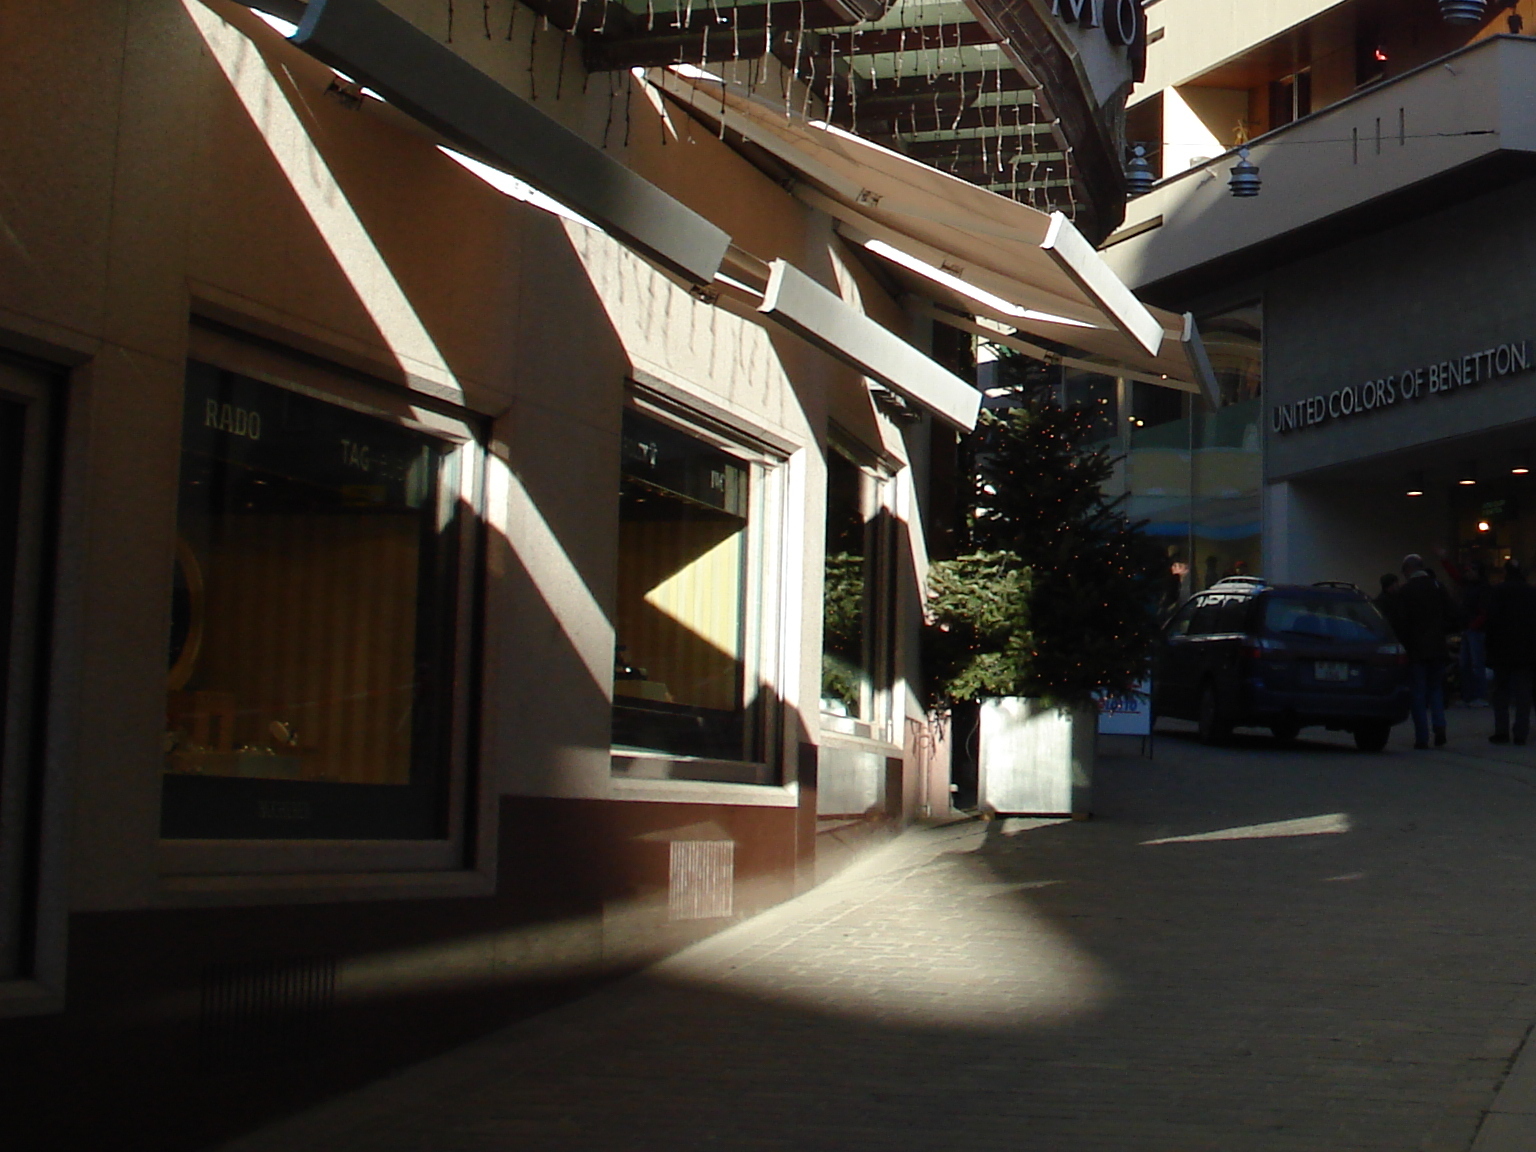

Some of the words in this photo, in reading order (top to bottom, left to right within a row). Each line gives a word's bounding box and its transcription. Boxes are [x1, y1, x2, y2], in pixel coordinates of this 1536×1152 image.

[205, 399, 261, 440] RADO
[1272, 396, 1325, 433] UNITED
[1328, 376, 1395, 418] COLORS
[1400, 368, 1423, 400] OF
[341, 438, 370, 472] TAG
